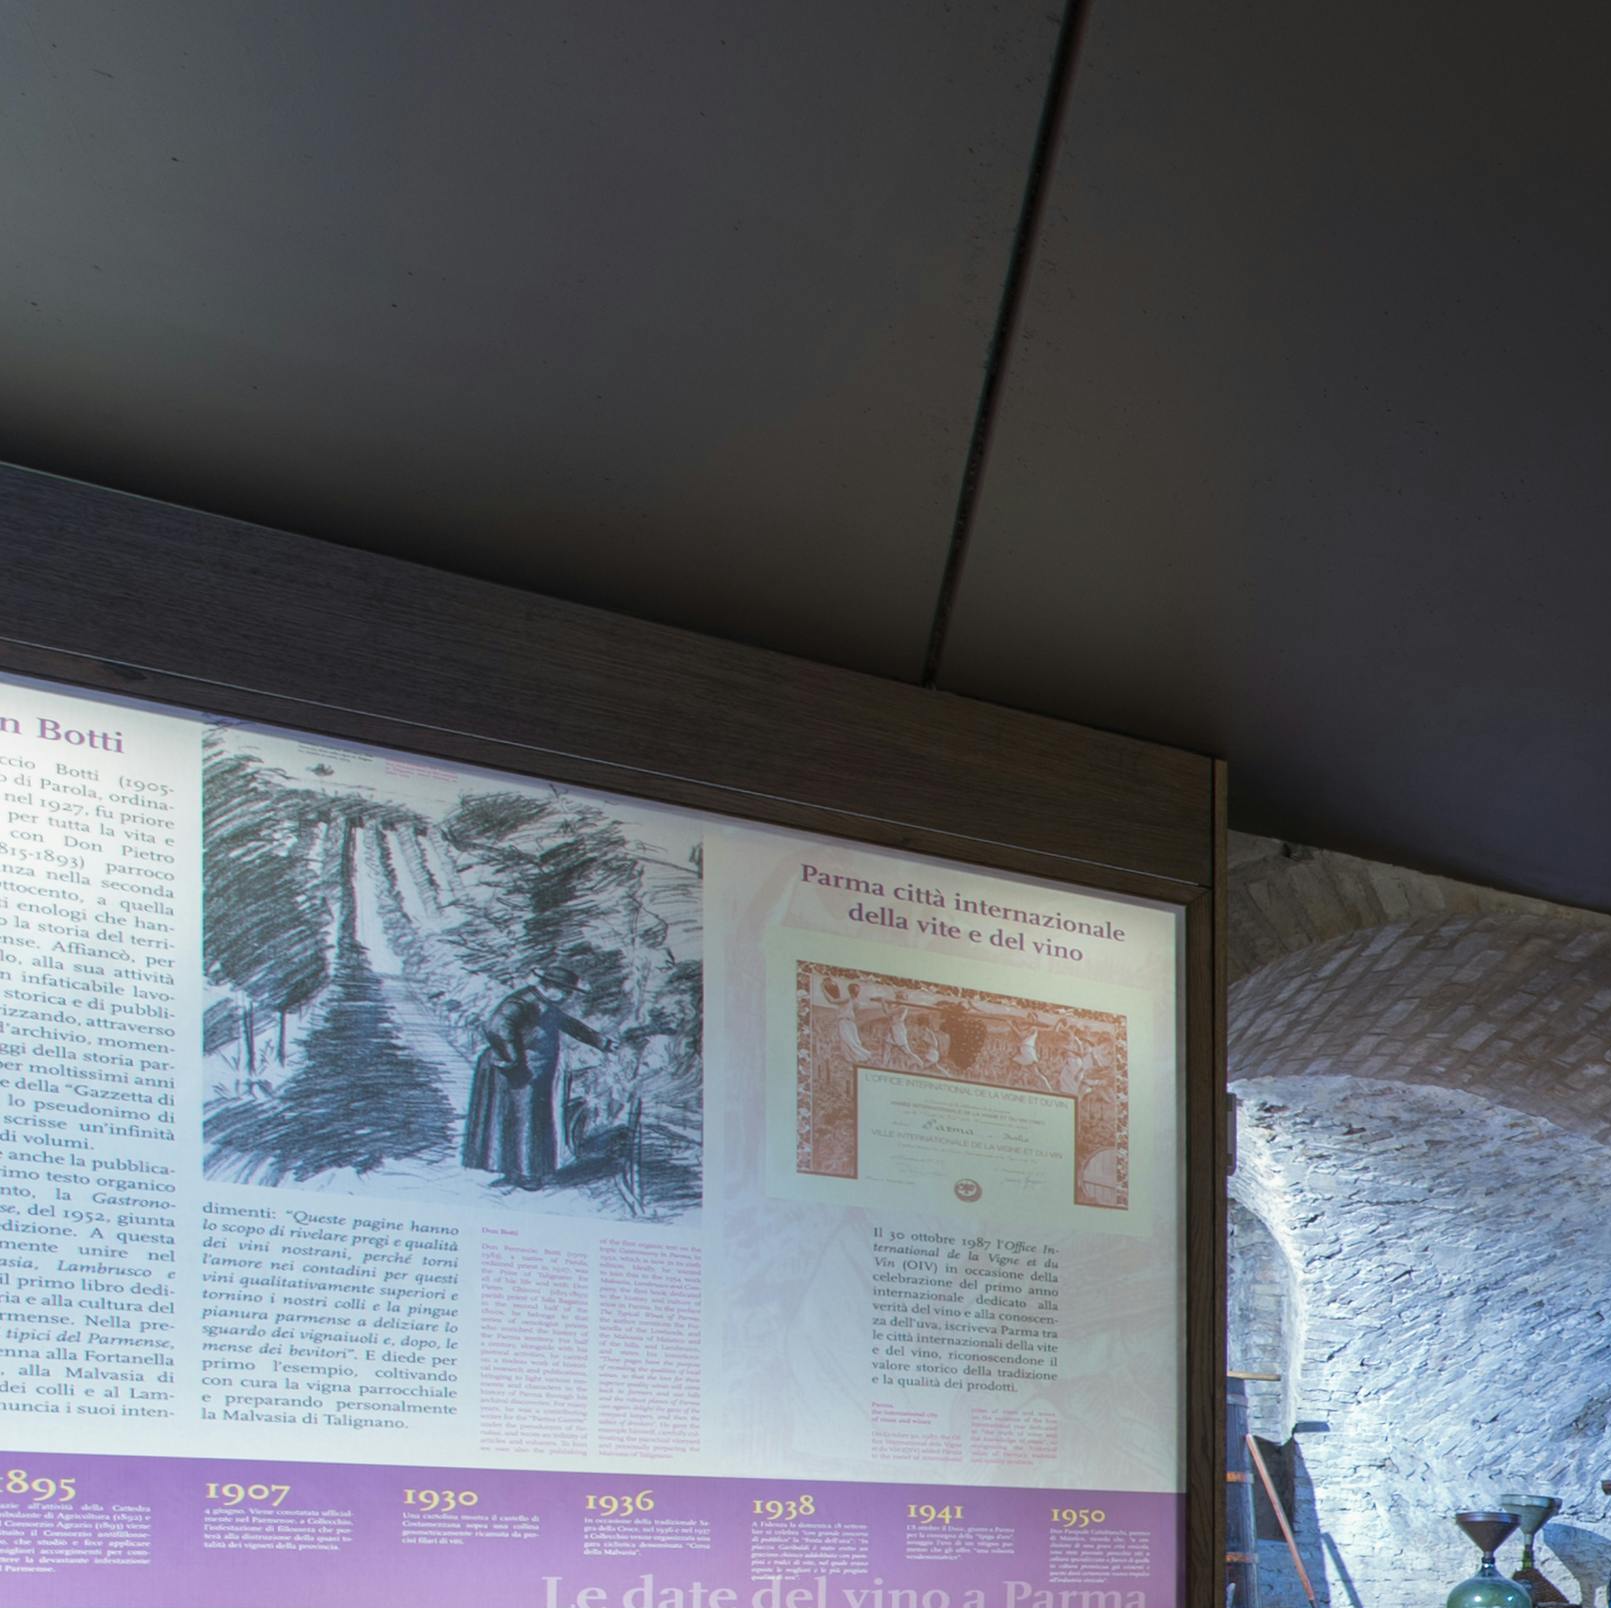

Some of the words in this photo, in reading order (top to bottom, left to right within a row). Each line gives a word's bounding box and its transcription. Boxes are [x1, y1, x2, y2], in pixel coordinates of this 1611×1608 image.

[36, 717, 124, 753] Botti
[7, 810, 39, 824] per
[47, 816, 90, 832] tutta
[99, 821, 115, 837] la
[123, 828, 156, 844] vita
[9, 830, 44, 843] con
[63, 834, 102, 852] Don
[121, 844, 175, 864] Pietro
[799, 862, 886, 897] Parma
[892, 882, 945, 908] città
[953, 891, 1124, 941] internazionale
[849, 901, 908, 930] della
[917, 916, 961, 941] vite
[990, 927, 1025, 951] del
[1032, 938, 1083, 962] vino
[201, 1200, 276, 1219] dimenti:
[351, 1217, 403, 1232] pagine
[409, 1219, 459, 1235] hanno
[202, 1217, 218, 1231] lo
[220, 1223, 265, 1237] scopo
[268, 1224, 285, 1237] di
[289, 1226, 348, 1242] rivelare
[350, 1234, 389, 1249] pregi
[404, 1238, 458, 1252] qualità
[873, 1226, 882, 1237] Il
[889, 1231, 905, 1241] 30
[910, 1232, 955, 1245] ottobre
[961, 1236, 991, 1250] 1987
[1042, 1244, 1059, 1254] In-
[201, 1235, 227, 1248] dei
[238, 1239, 270, 1252] vini
[281, 1245, 351, 1260] nostrani,
[362, 1251, 412, 1264] perché
[421, 1256, 458, 1268] torni
[873, 1242, 939, 1257] ternational
[946, 1248, 960, 1259] de
[967, 1250, 979, 1261] la
[988, 1252, 1019, 1267] Vigne
[1026, 1258, 1036, 1266] et
[1043, 1258, 1058, 1269] du
[269, 1260, 294, 1271] nei
[301, 1264, 376, 1277] contadini
[383, 1270, 408, 1282] per
[414, 1272, 458, 1285] questi
[874, 1256, 895, 1268] Vin
[902, 1259, 937, 1274] (OIV)
[945, 1263, 958, 1274] in
[964, 1267, 1024, 1280] occasione
[1029, 1270, 1058, 1283] della
[202, 1270, 234, 1283] vini
[238, 1274, 375, 1294] qualitativamente
[378, 1287, 446, 1300] superiori
[5, 1327, 51, 1343] tipici
[55, 1329, 81, 1343] del
[87, 1332, 174, 1349] Parmense,
[206, 1483, 290, 1506] 1907
[403, 1489, 479, 1511] 1930
[585, 1490, 655, 1516] 1936
[753, 1495, 816, 1520] 1938
[907, 1504, 964, 1524] 1941
[1052, 1508, 1106, 1527] 1950
